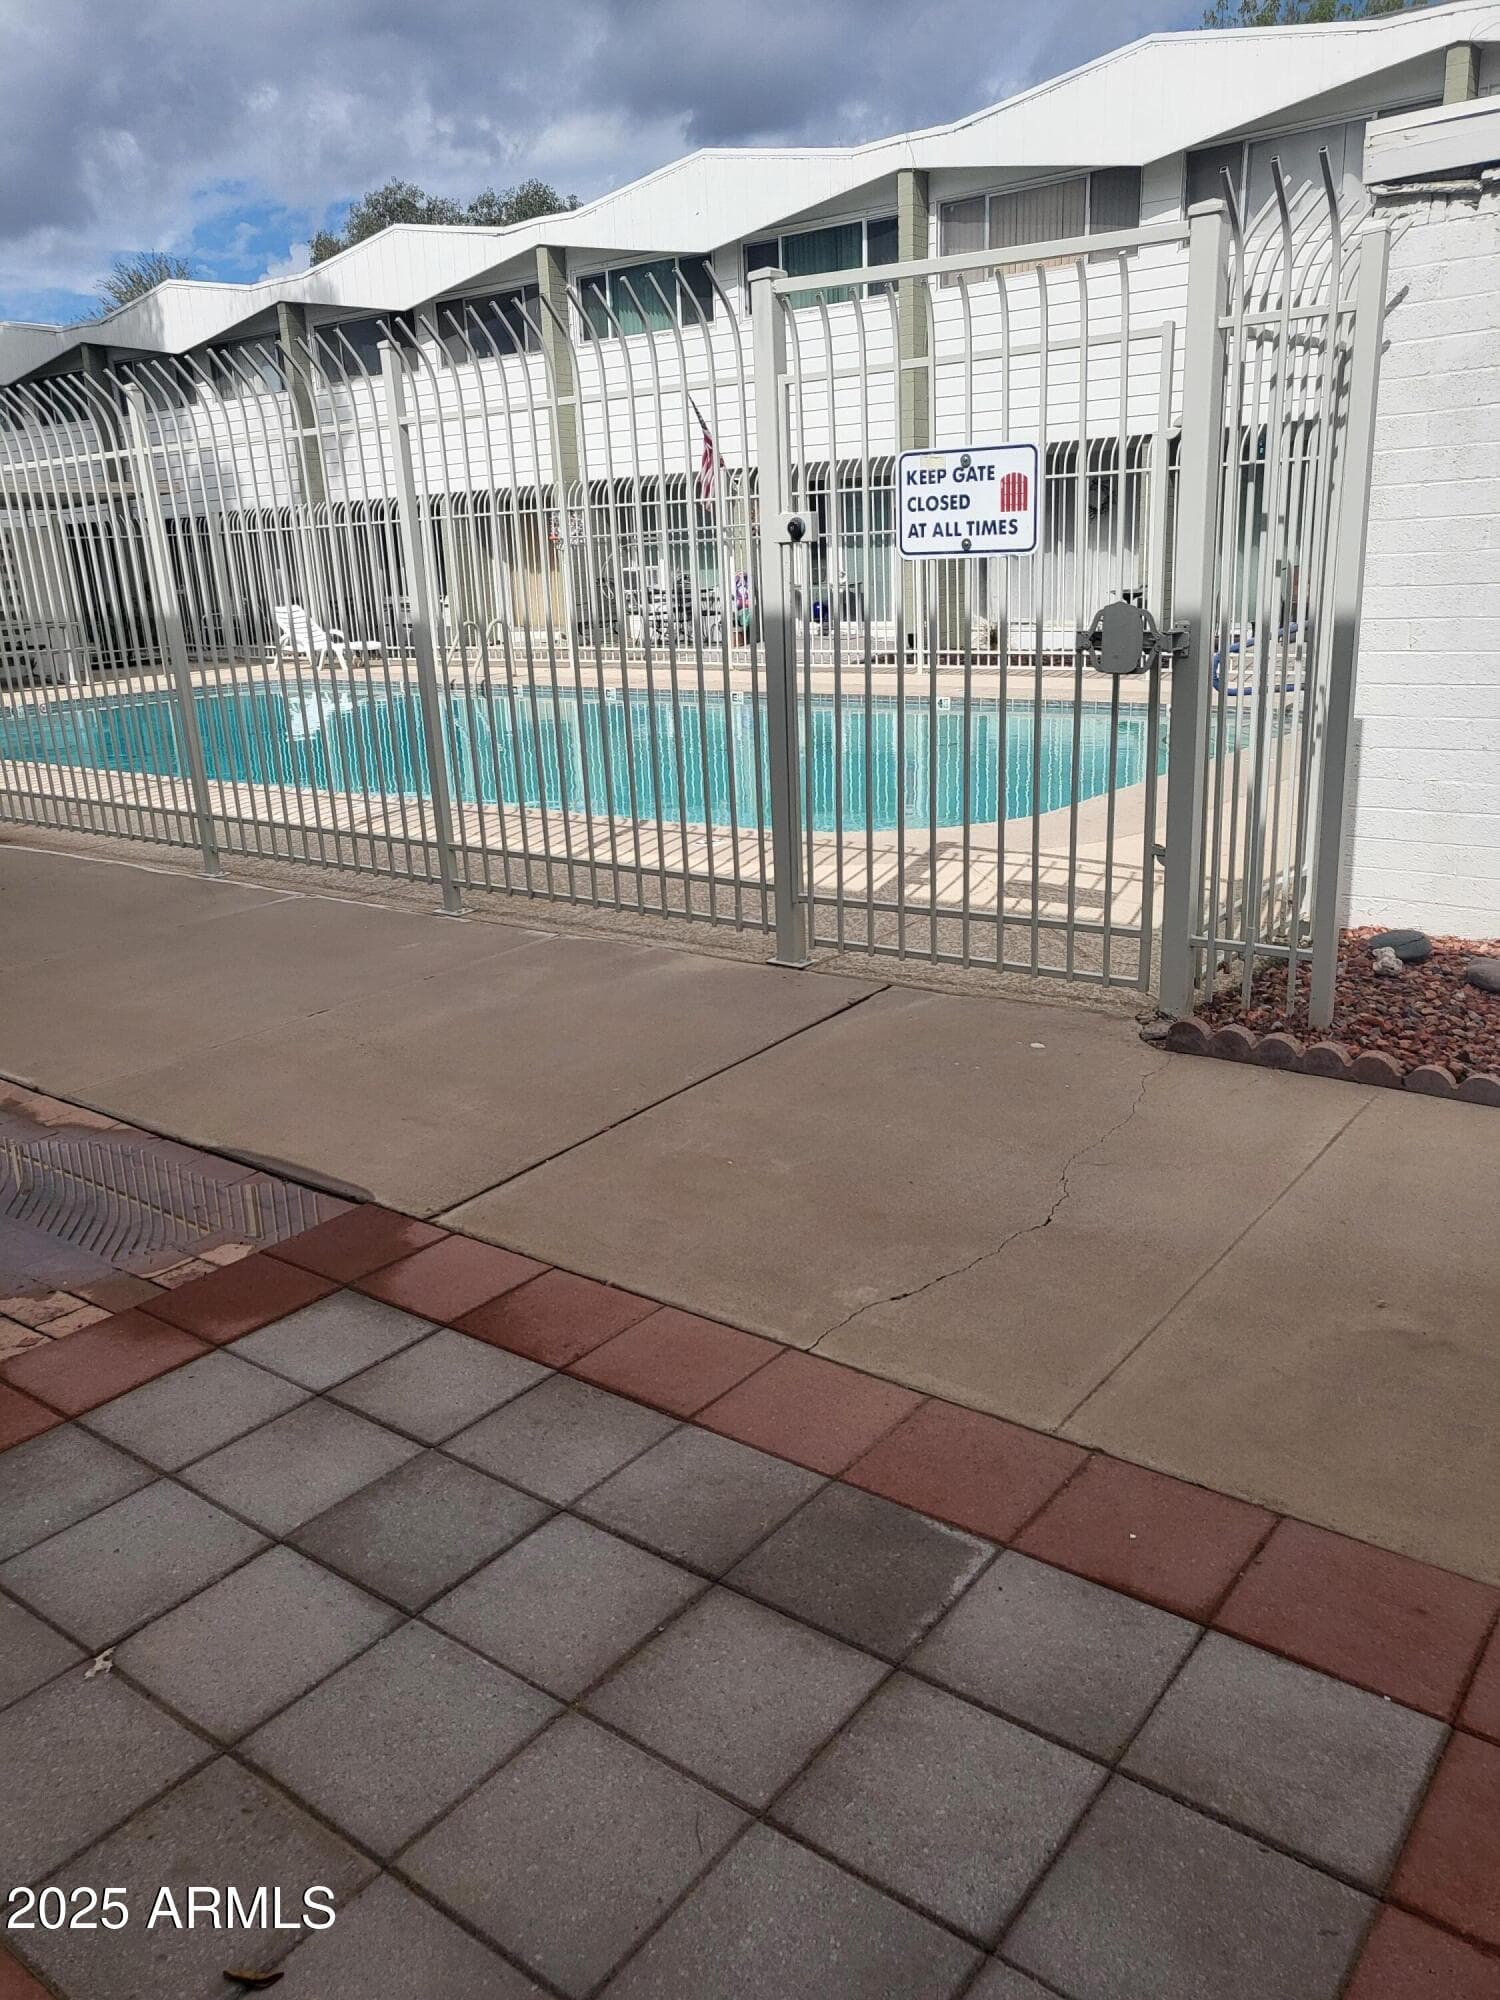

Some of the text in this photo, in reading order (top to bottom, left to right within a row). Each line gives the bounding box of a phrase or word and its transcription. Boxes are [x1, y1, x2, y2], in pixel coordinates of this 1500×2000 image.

[906, 465, 996, 486] KEEP GATE
[907, 494, 971, 512] CLOSED
[908, 518, 1018, 539] AT ALL TIMES
